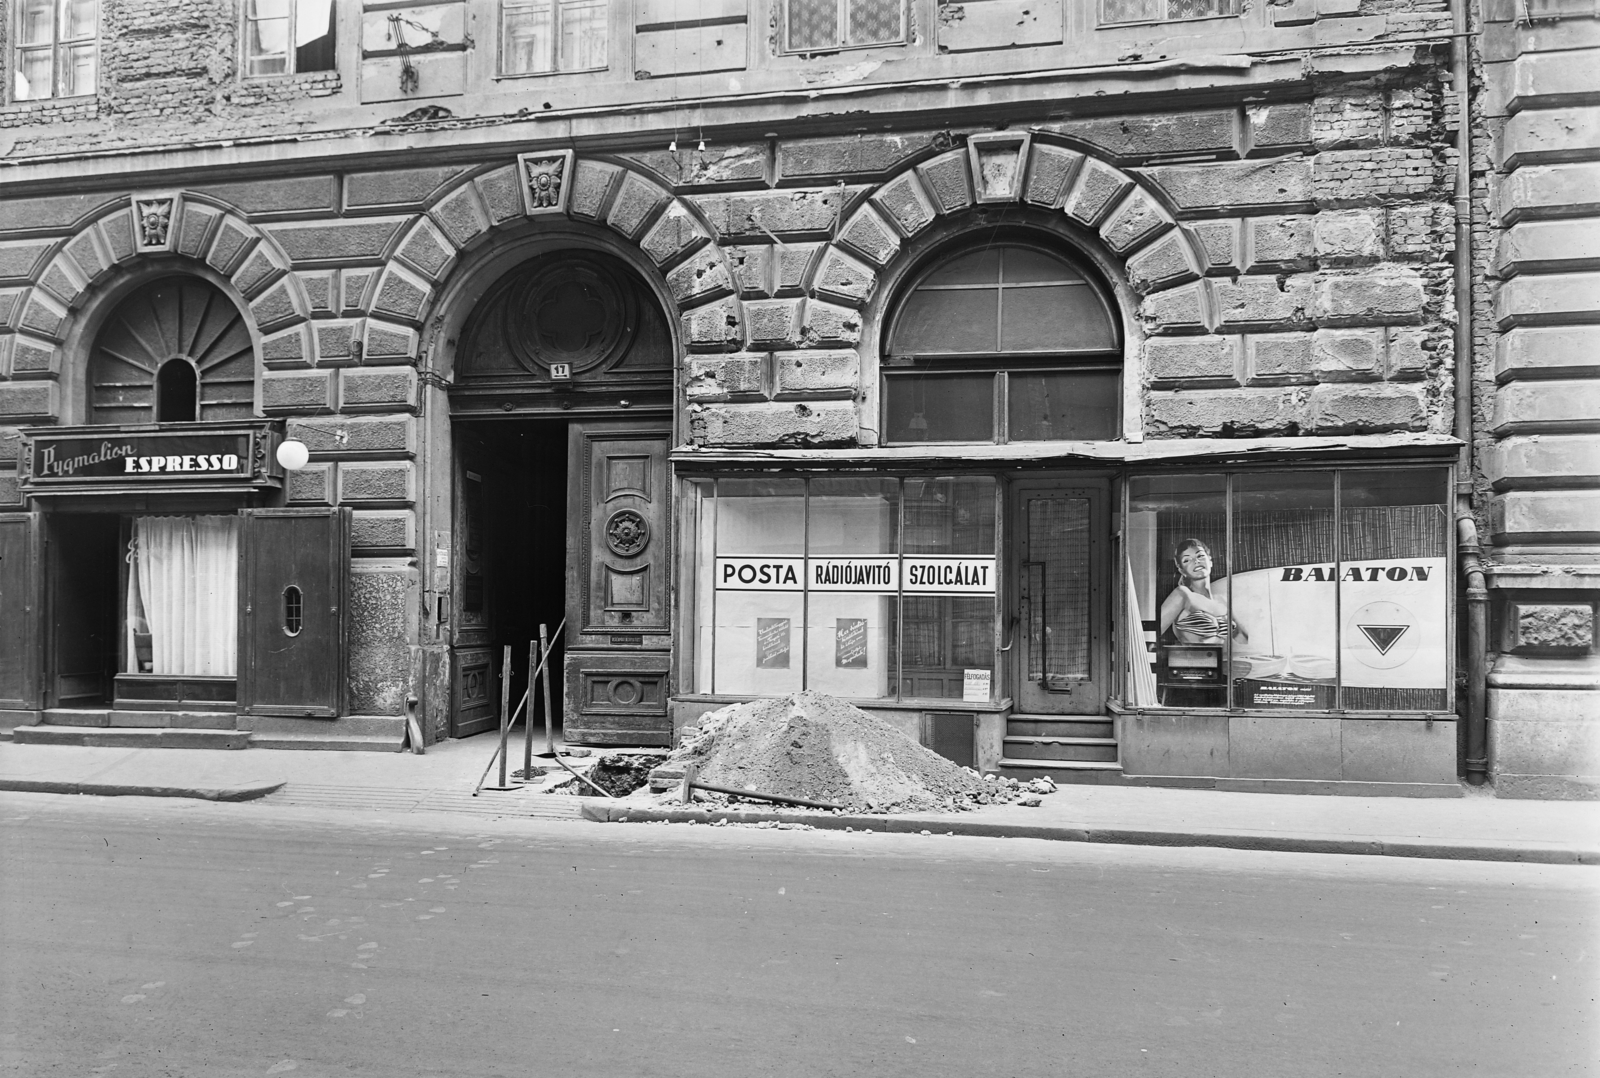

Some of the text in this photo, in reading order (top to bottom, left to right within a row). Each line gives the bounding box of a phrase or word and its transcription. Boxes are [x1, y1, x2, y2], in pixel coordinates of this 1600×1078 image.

[554, 364, 566, 375] 17
[40, 441, 137, 476] Pygmalion
[124, 454, 238, 473] ESPRESSO
[723, 561, 989, 586] POSTA RÁDIÓJAVITÓ SZOLGÁLAT
[1280, 566, 1433, 582] BALATON
